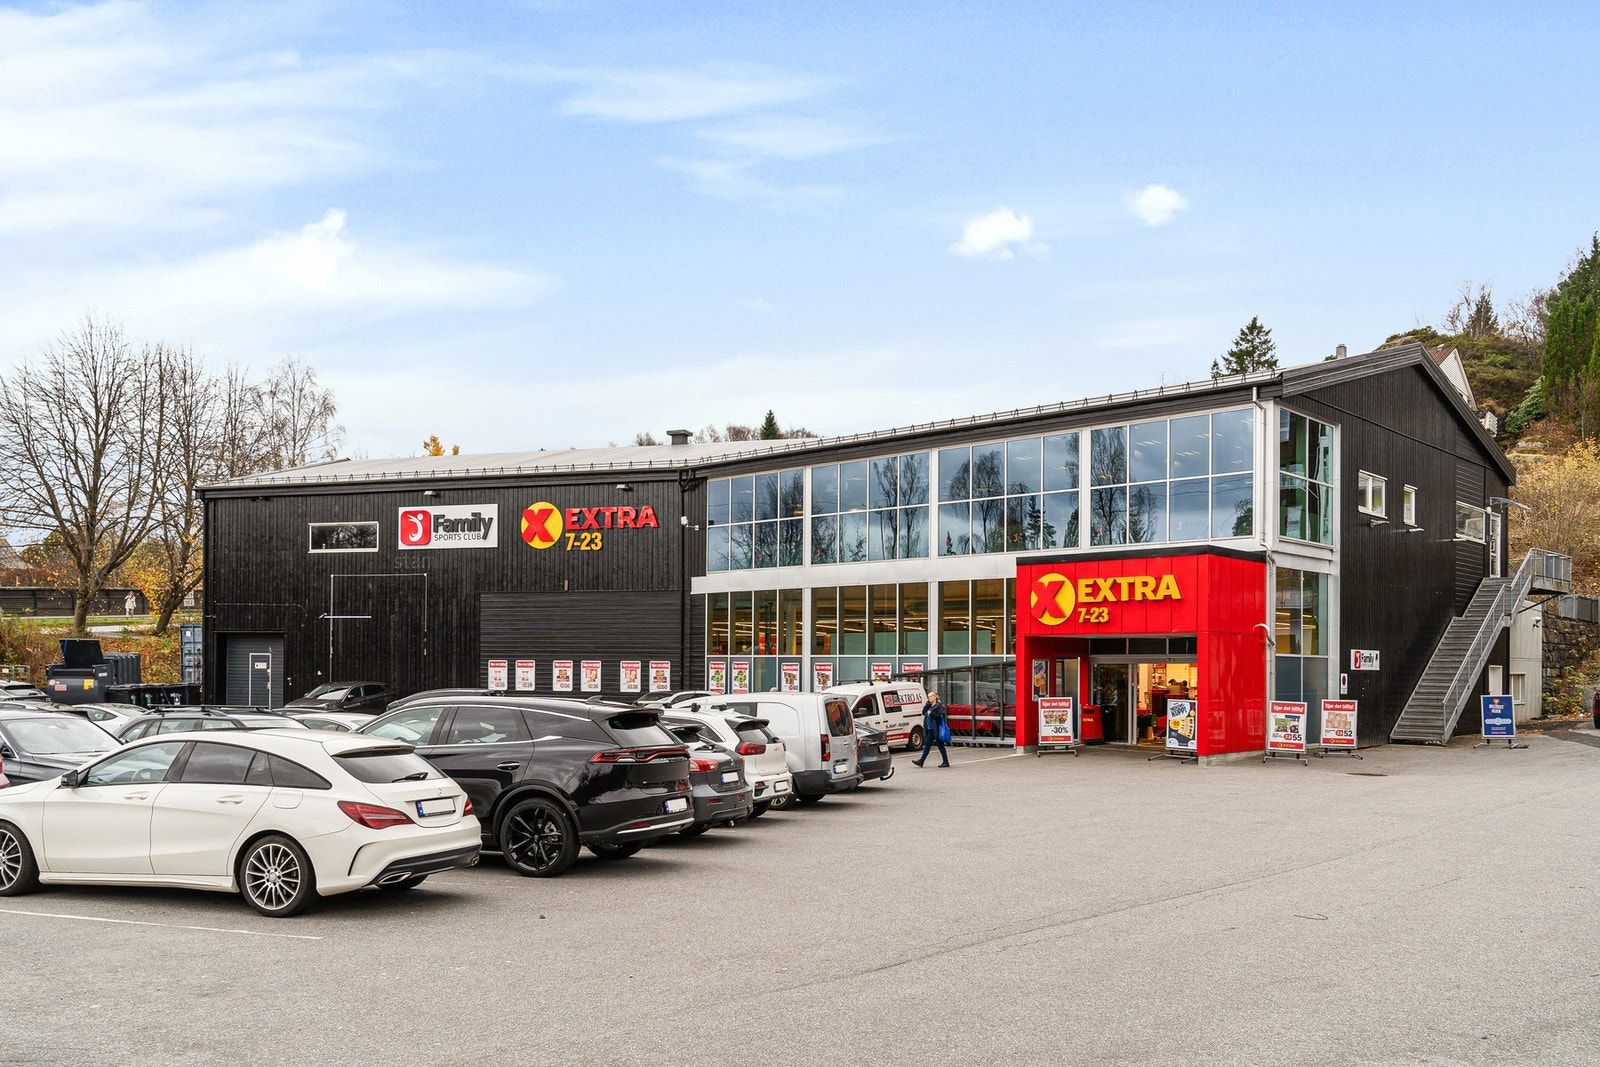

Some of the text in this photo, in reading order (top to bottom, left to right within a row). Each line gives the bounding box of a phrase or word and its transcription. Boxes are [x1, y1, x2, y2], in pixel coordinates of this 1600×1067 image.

[432, 511, 494, 540] Family
[565, 505, 659, 530] EXTRA
[434, 532, 482, 542] SPORTS CLUB
[565, 532, 602, 551] 7-23
[1077, 574, 1182, 603] EXTRA
[1077, 606, 1109, 624] 7-23
[1051, 726, 1069, 734] -30%
[1292, 733, 1302, 741] 55
